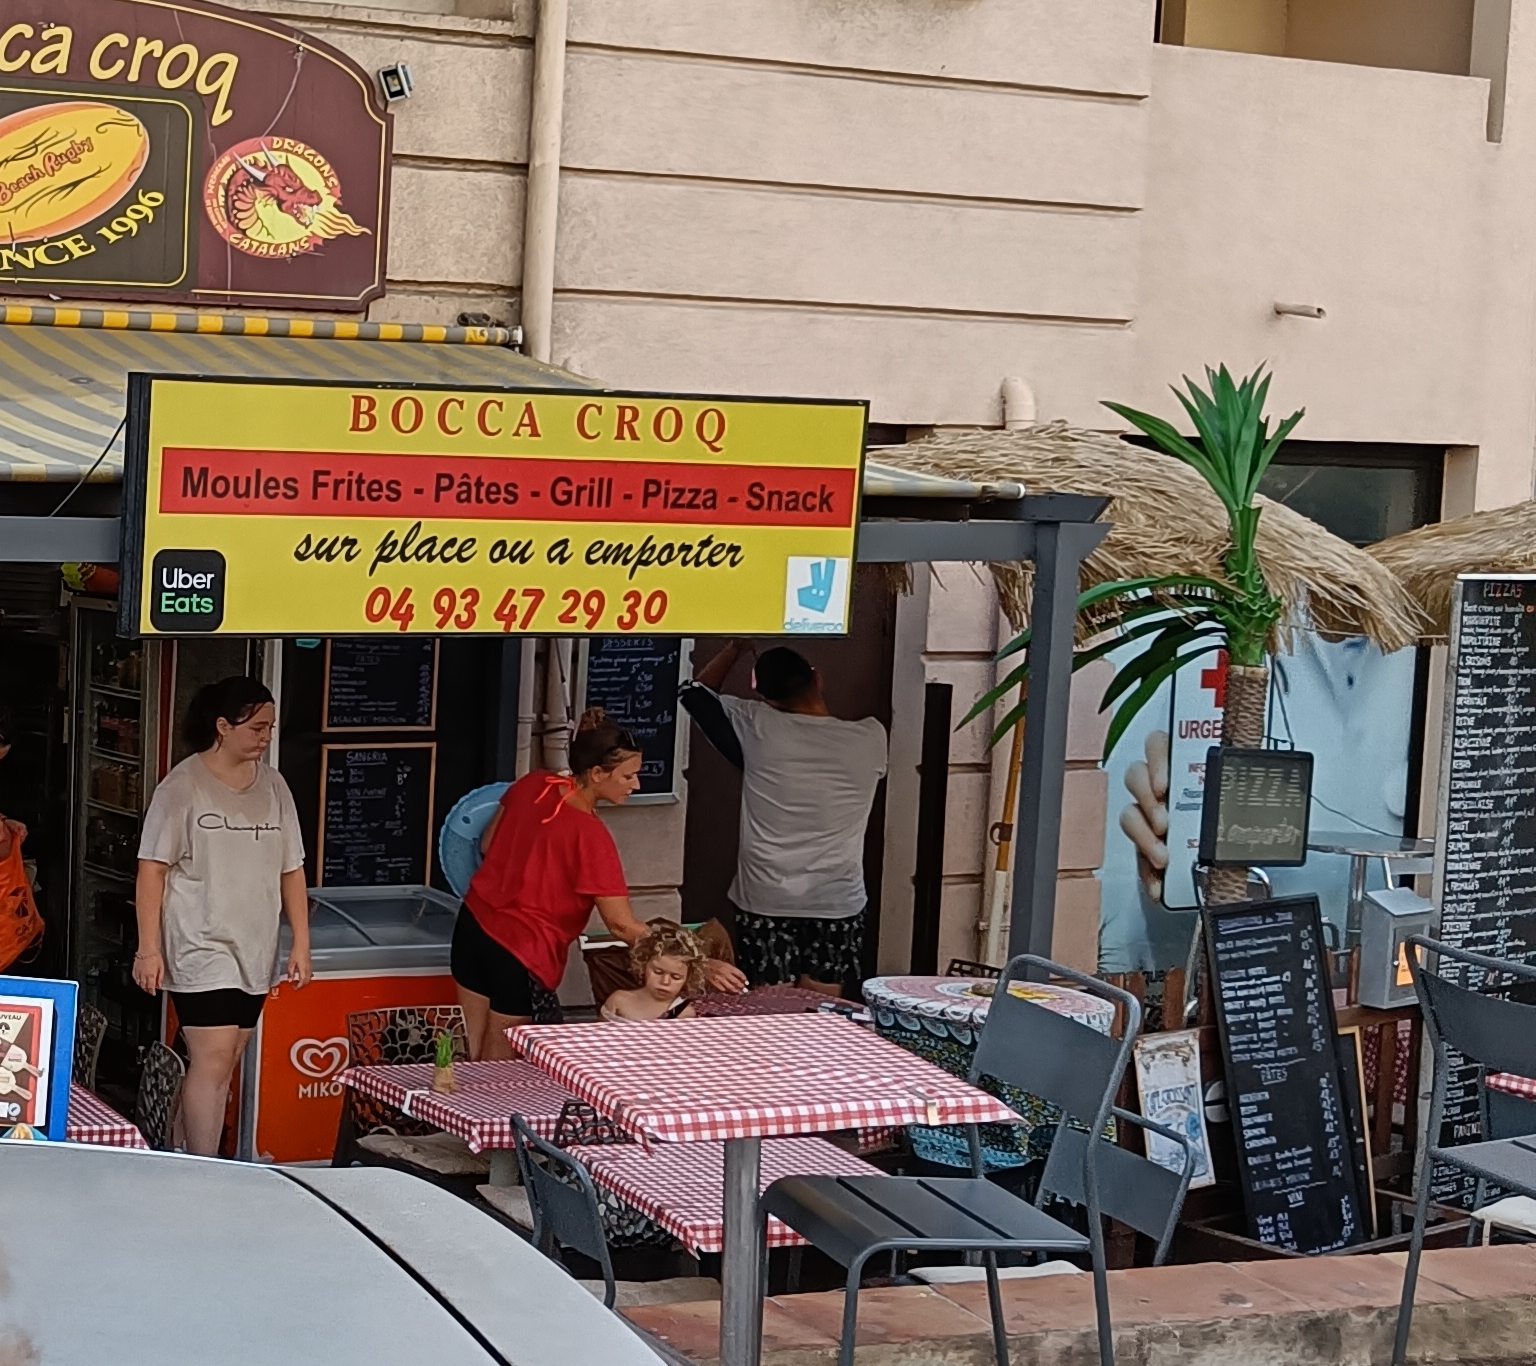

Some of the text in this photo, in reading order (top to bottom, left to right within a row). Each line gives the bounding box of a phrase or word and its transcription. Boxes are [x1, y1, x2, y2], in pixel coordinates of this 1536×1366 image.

[90, 32, 239, 125] croq
[43, 137, 94, 176] Rugby
[272, 137, 338, 187] DRAGONS
[96, 189, 165, 244] 1996
[229, 233, 310, 257] CATALANS
[349, 393, 728, 453] BOCCA CROQ
[181, 466, 300, 501] Moules
[311, 469, 402, 504] Frites
[433, 472, 520, 508] Pâtes
[549, 476, 614, 509] Grill
[642, 478, 719, 512] Pizza
[745, 481, 835, 514] Snack
[293, 531, 361, 565] sur
[369, 520, 478, 576] place
[488, 535, 537, 565] ou
[584, 533, 745, 580] emporter
[162, 567, 215, 589] Uber
[161, 592, 214, 613] Eats
[364, 586, 669, 632] 04 93 47 29 30
[297, 1082, 344, 1099] MIKO
